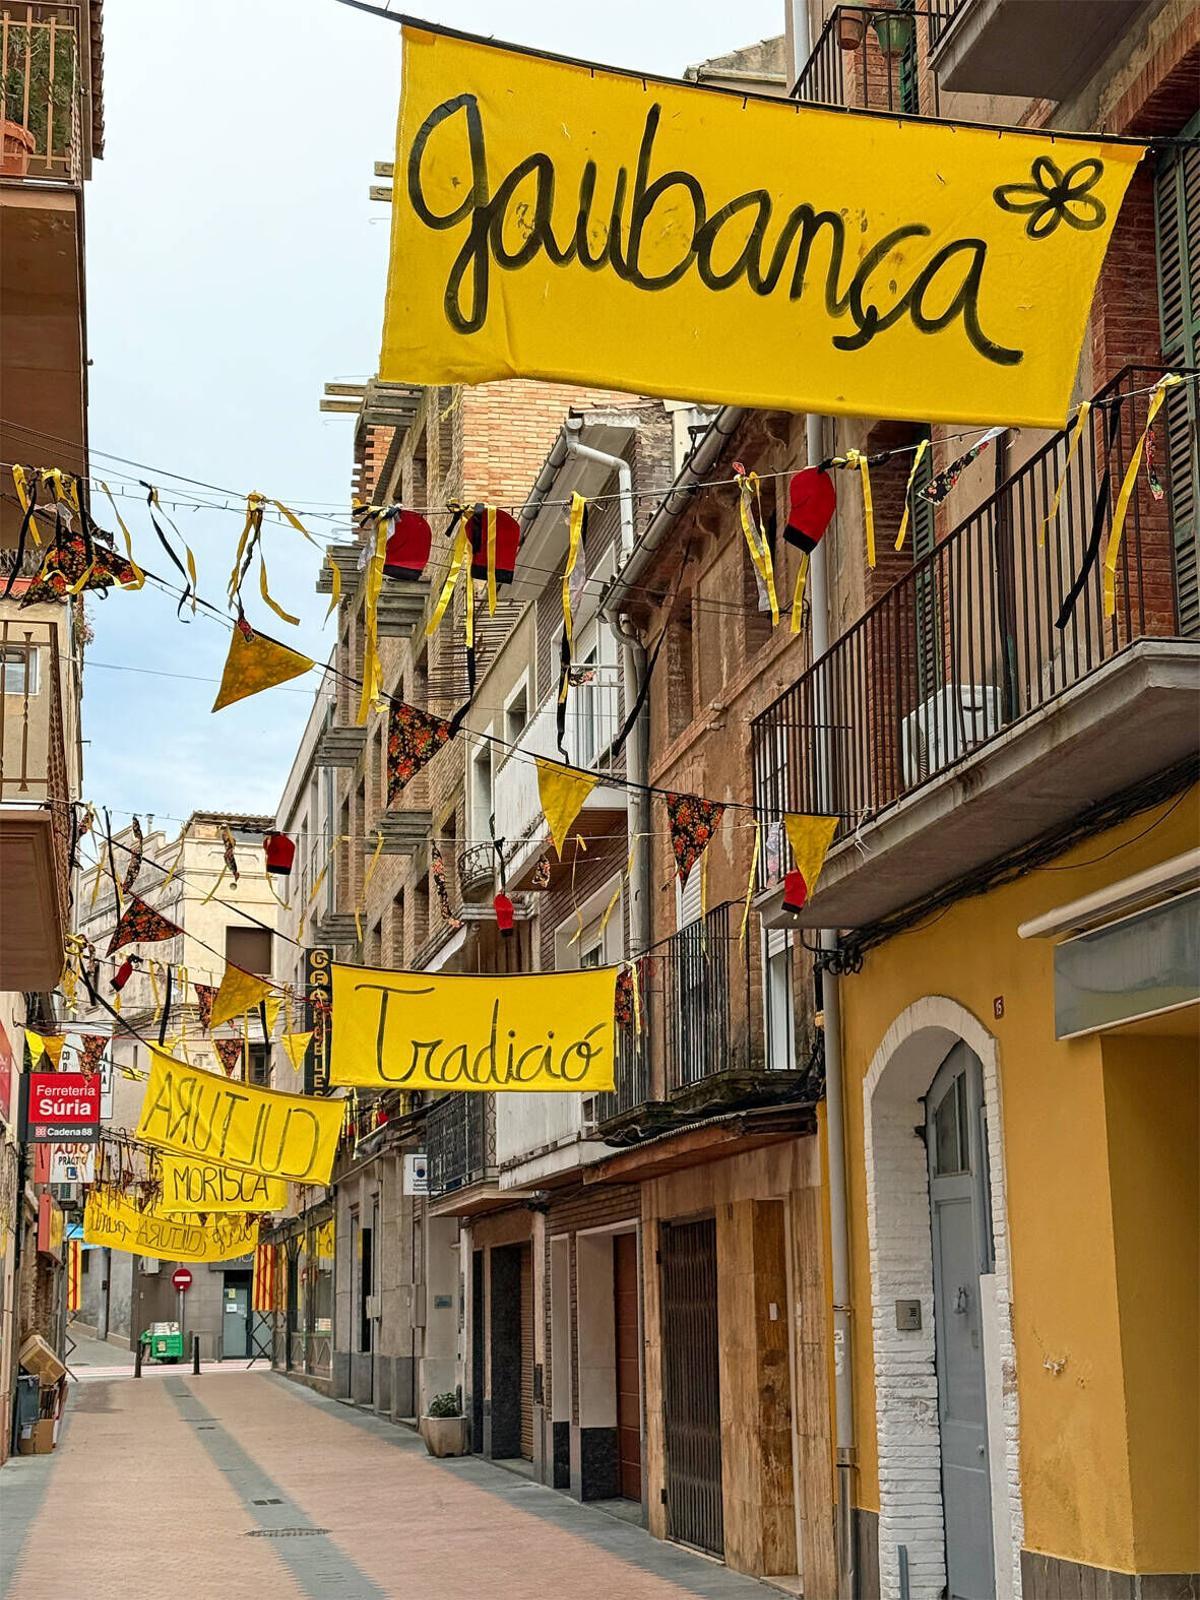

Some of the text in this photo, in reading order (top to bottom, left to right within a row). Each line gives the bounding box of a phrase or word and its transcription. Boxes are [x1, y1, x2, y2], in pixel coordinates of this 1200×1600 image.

[354, 984, 607, 1084] Tradició
[39, 1098, 92, 1116] Súria
[173, 1166, 270, 1203] MORISCA
